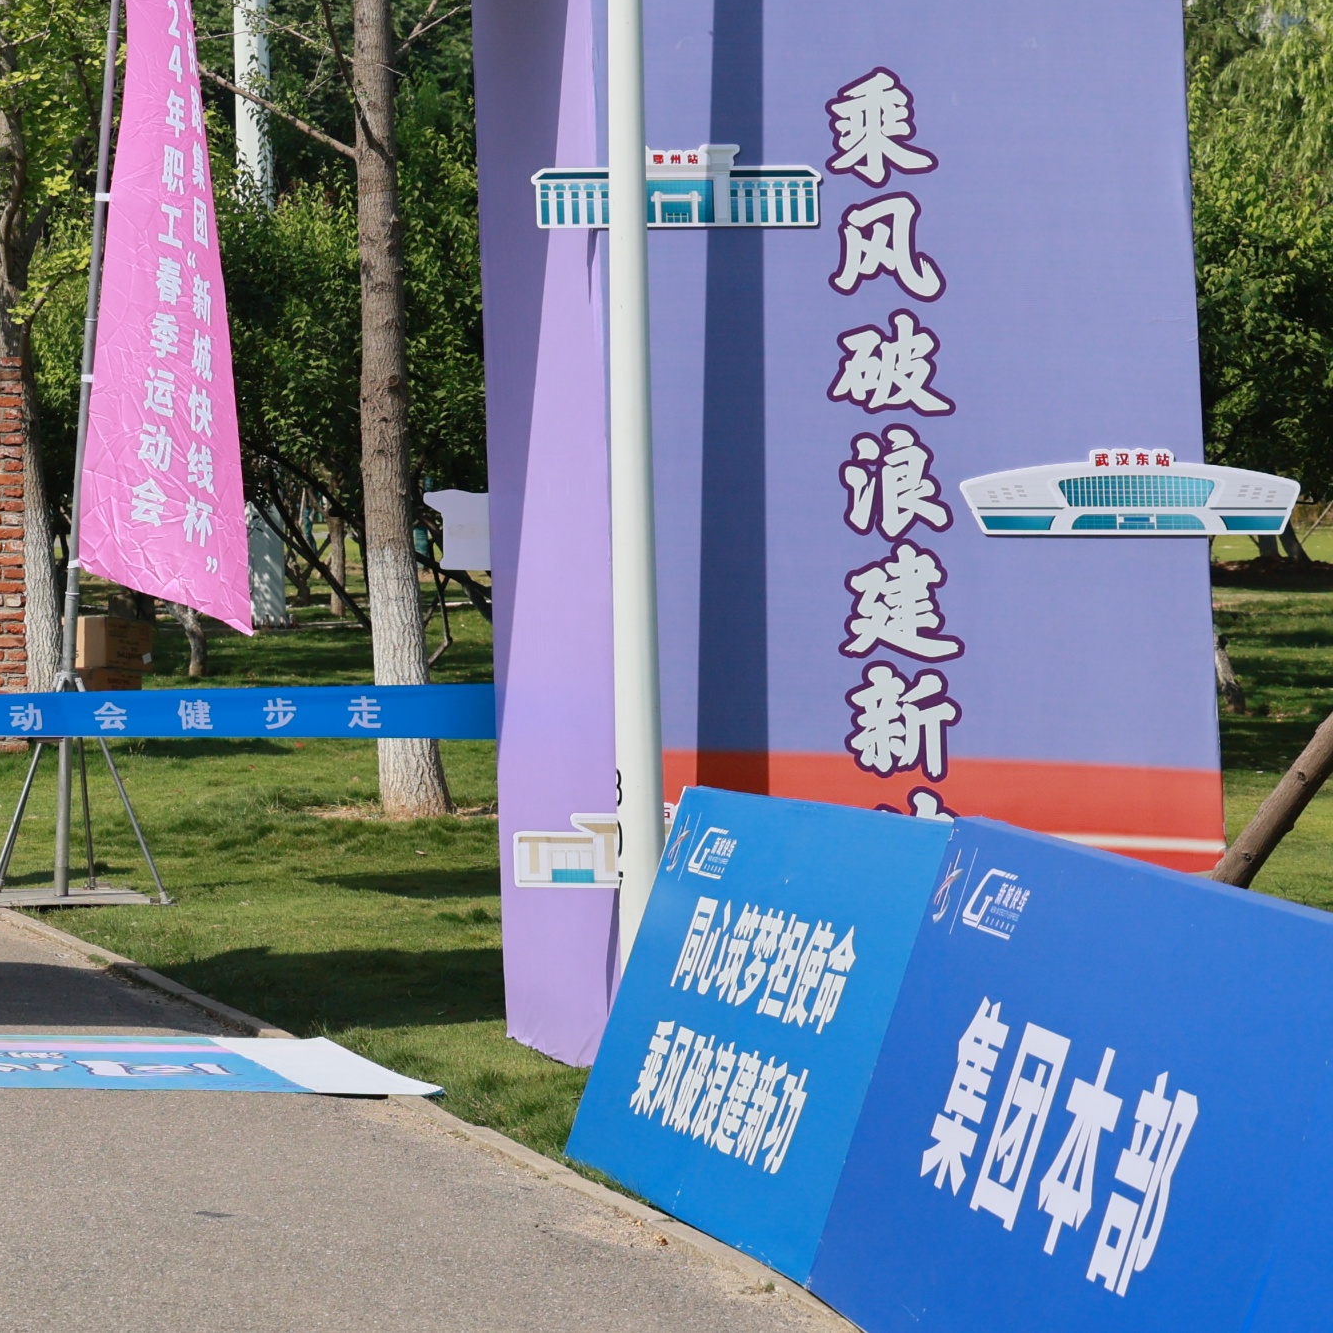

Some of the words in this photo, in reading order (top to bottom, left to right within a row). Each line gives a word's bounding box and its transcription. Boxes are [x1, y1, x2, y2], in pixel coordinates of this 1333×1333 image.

[652, 154, 698, 165] 鄂州站
[827, 67, 965, 822] 乘风破浪建新
[1095, 453, 1170, 467] 武汉东站
[670, 896, 857, 1036] 同心筑梦担使命
[628, 1020, 810, 1176] 乘风破浪建新功
[920, 995, 1199, 1298] 集团本部
